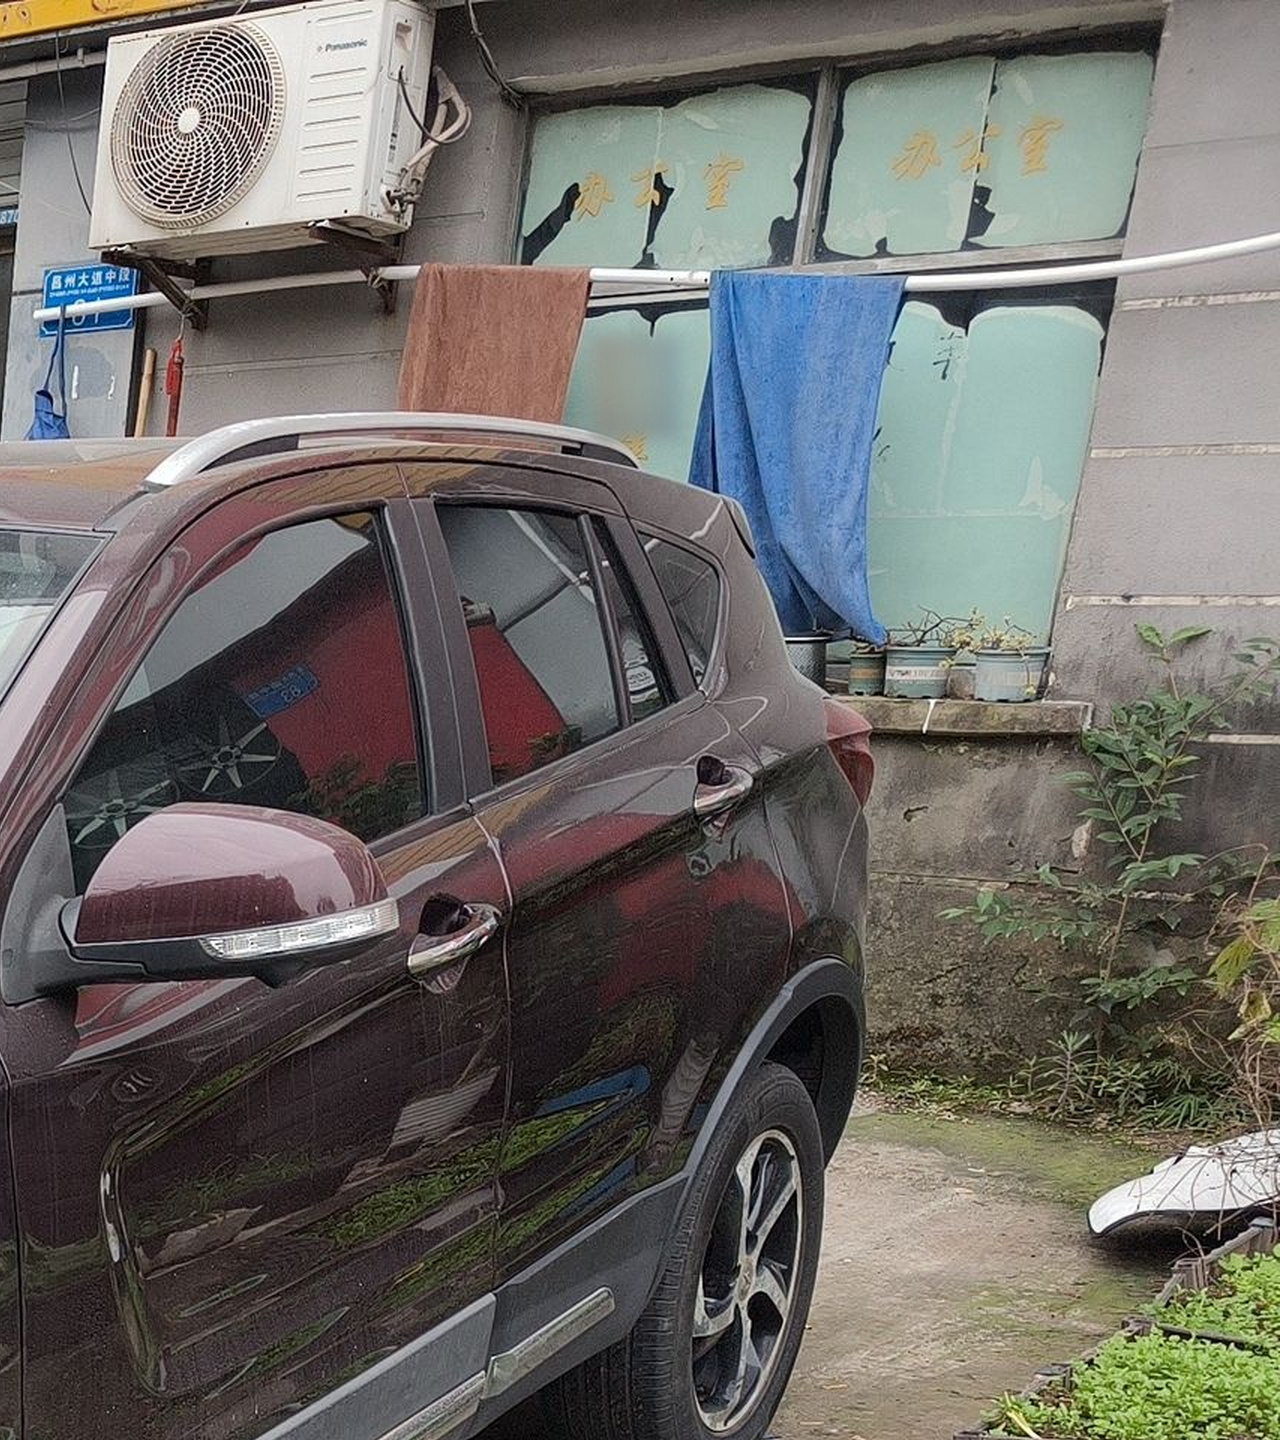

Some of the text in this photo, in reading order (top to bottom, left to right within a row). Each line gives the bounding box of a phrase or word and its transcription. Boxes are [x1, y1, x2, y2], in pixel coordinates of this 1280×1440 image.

[325, 39, 368, 52] Panasonic
[51, 267, 131, 291] 昌州大道中段
